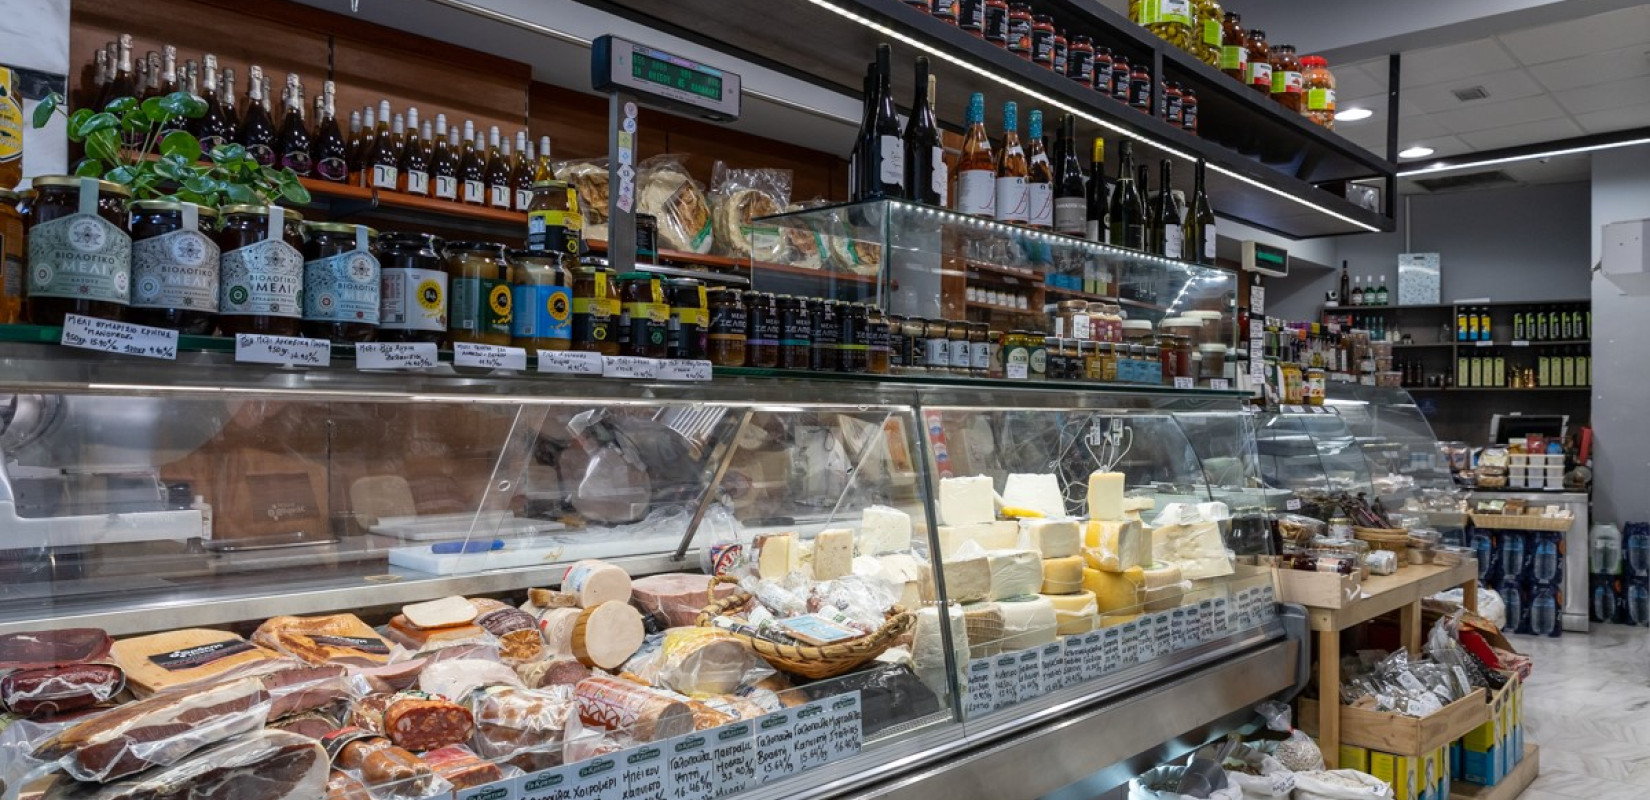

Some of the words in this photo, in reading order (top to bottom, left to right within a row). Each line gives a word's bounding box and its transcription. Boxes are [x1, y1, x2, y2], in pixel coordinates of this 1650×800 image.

[55, 252, 115, 265] ΒΙΟΛΟΓΙΚΟ
[61, 260, 107, 276] ΜΕΛΙ
[161, 265, 213, 277] ΒΙΟΛΟΓΙΚΟ
[249, 274, 297, 284] ΒΙΟΛΟΓΙΚΟ
[256, 282, 291, 294] ΜΕΛΙ
